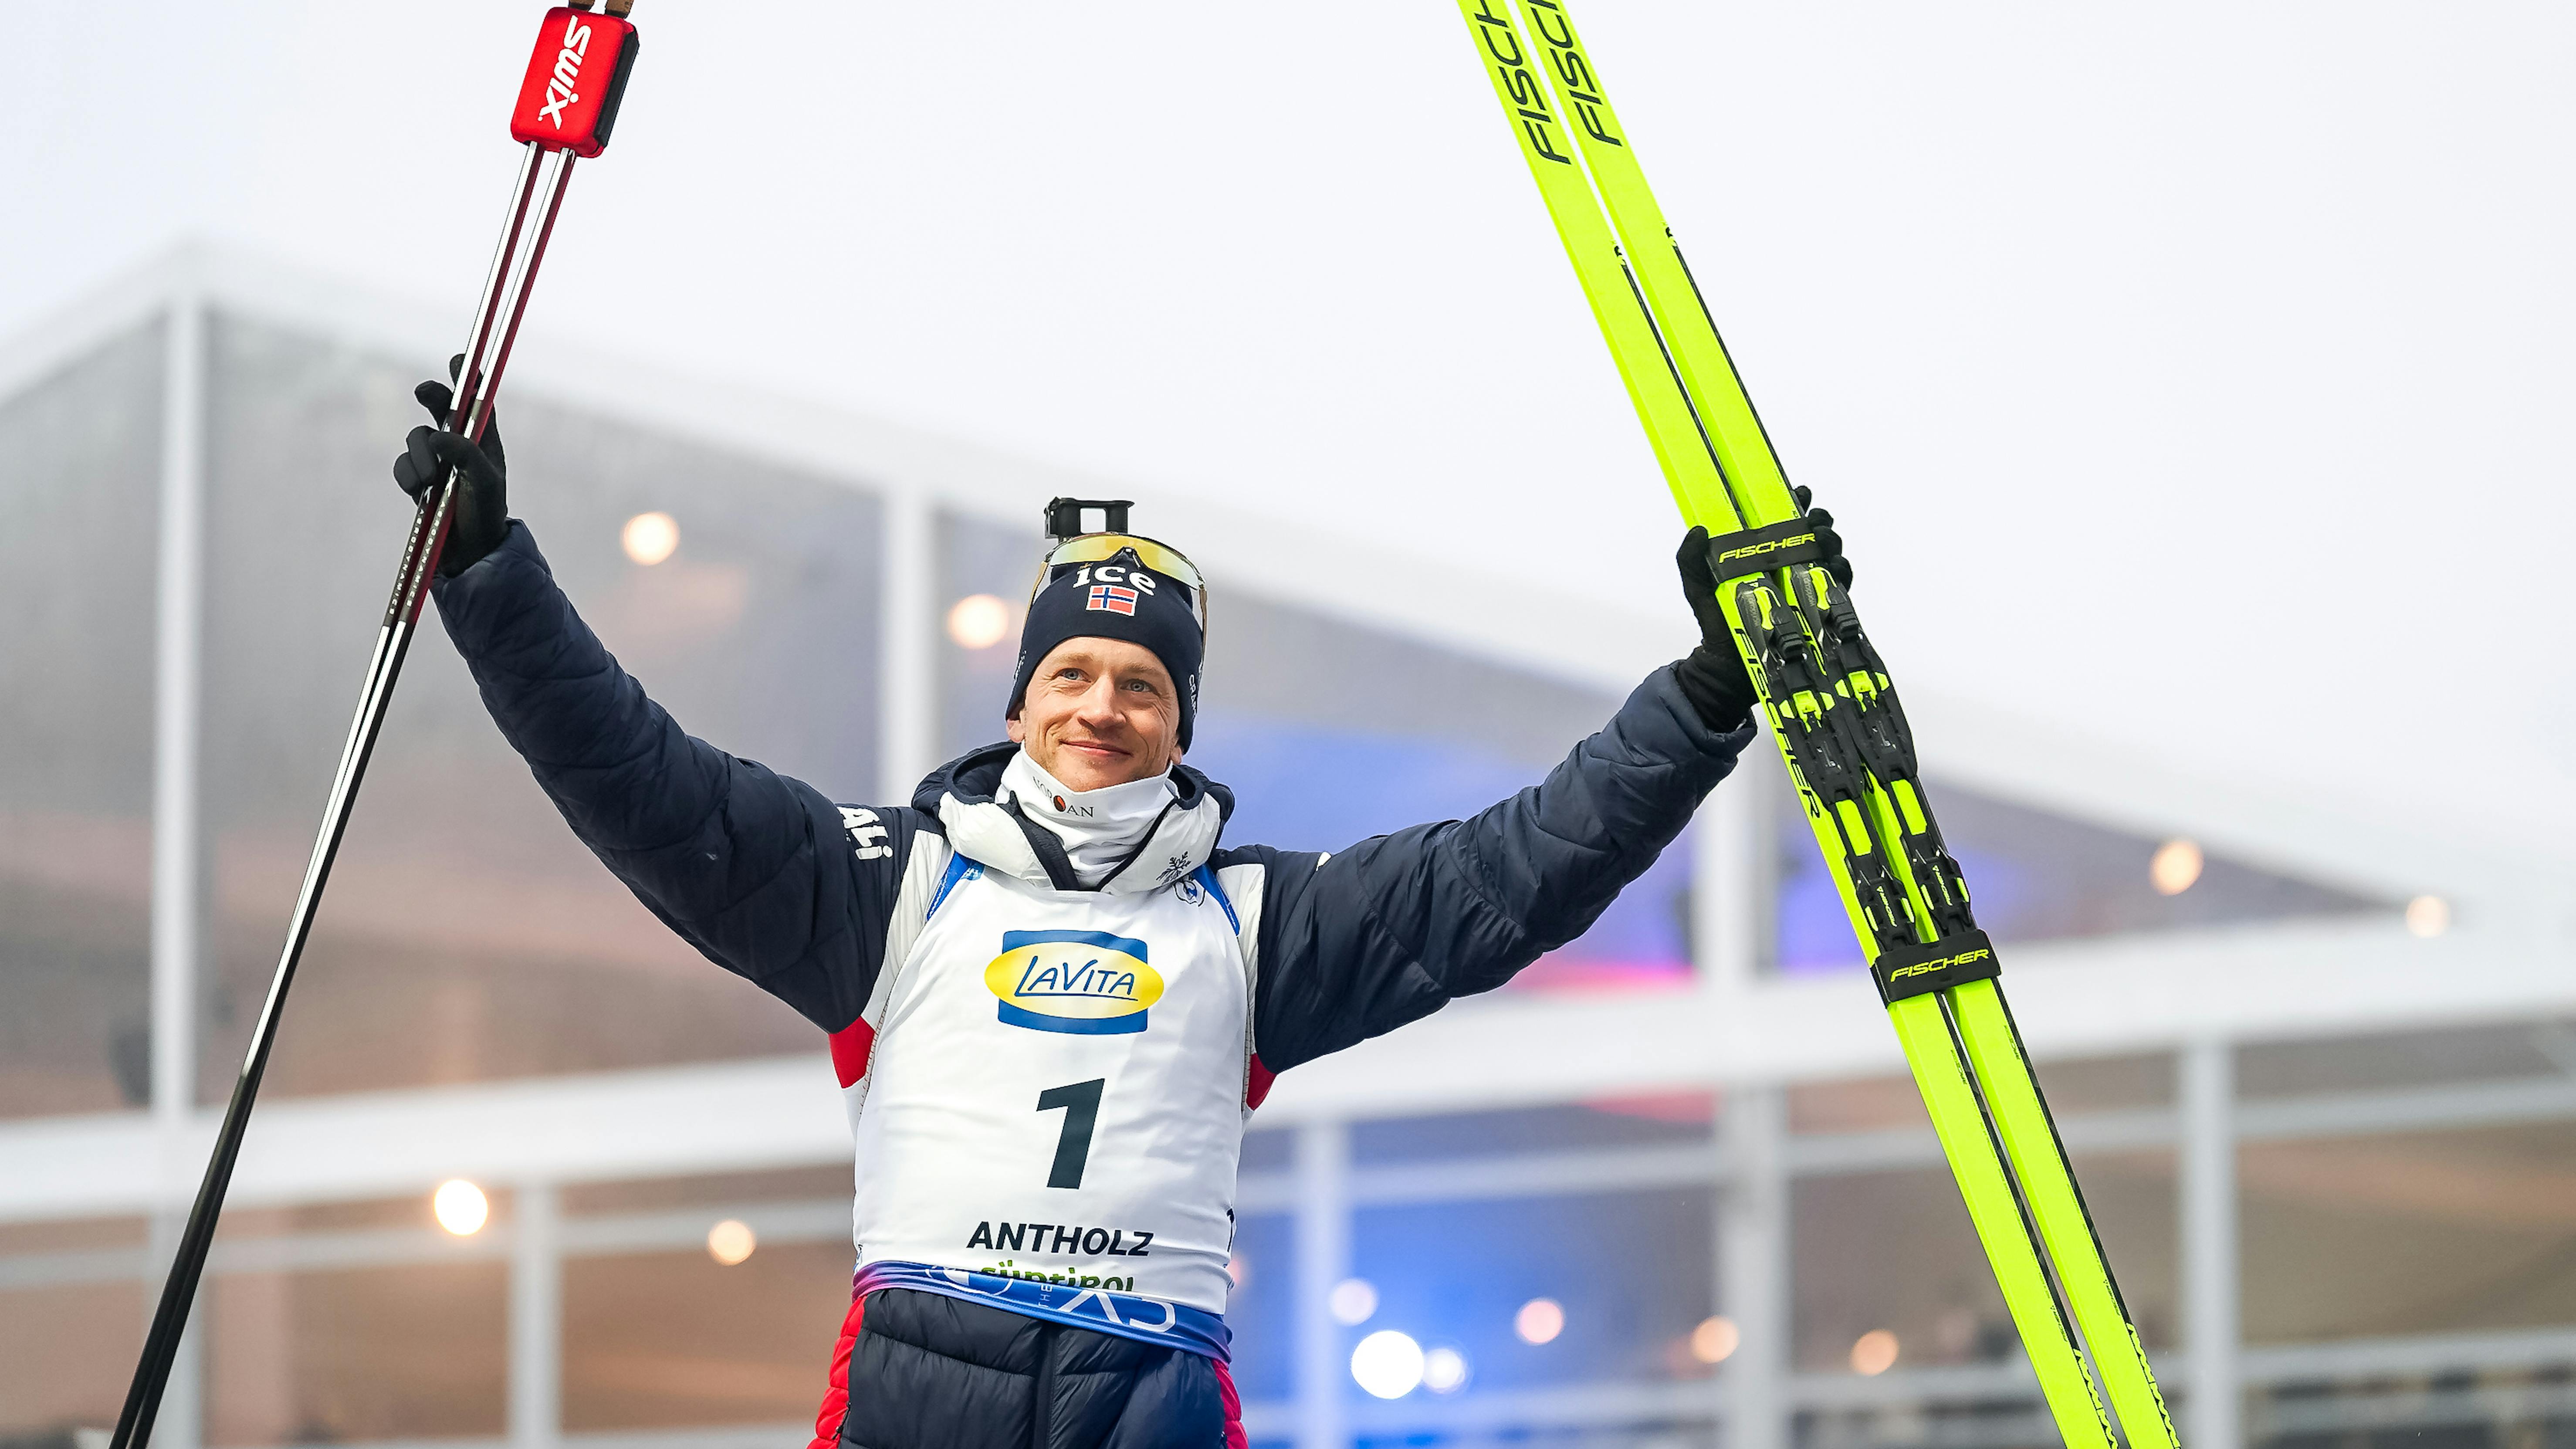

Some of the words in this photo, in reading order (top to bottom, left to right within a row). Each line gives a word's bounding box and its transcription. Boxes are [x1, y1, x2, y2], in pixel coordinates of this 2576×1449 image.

[1719, 532, 1816, 564] FISCHER
[1890, 948, 1989, 983] FISCHER
[1036, 1078, 1105, 1189] 1
[966, 1221, 1154, 1257] ANTHOLZ
